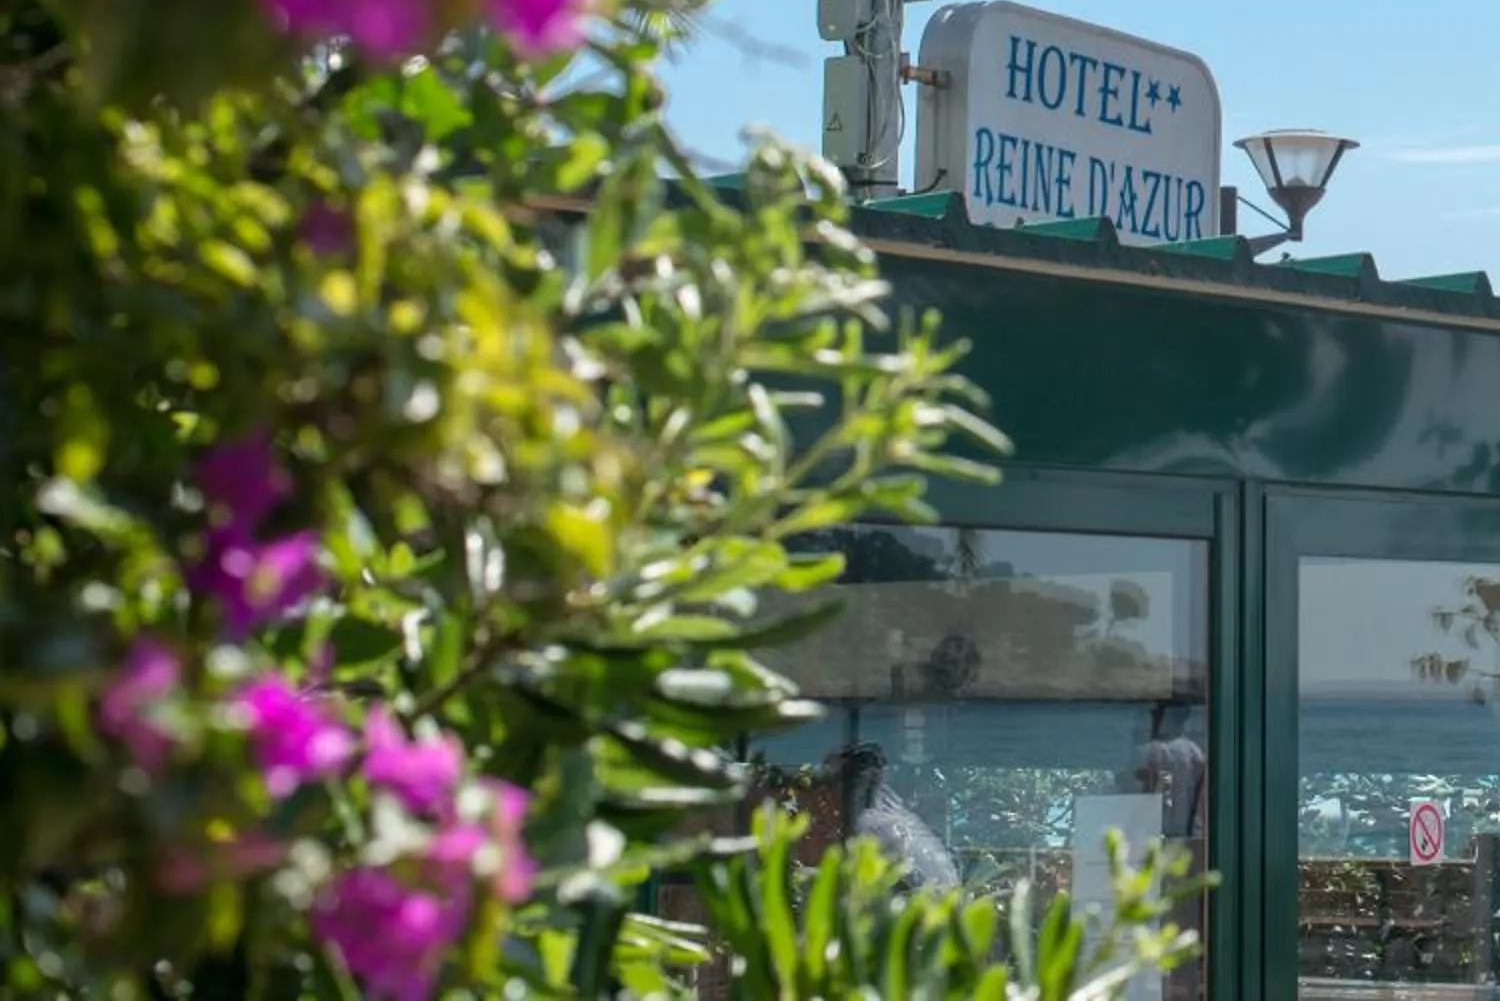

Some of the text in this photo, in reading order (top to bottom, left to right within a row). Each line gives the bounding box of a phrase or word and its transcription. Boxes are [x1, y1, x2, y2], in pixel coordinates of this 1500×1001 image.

[1005, 36, 1152, 134] HOTEL
[974, 127, 1206, 242] REINE D'AZUR
